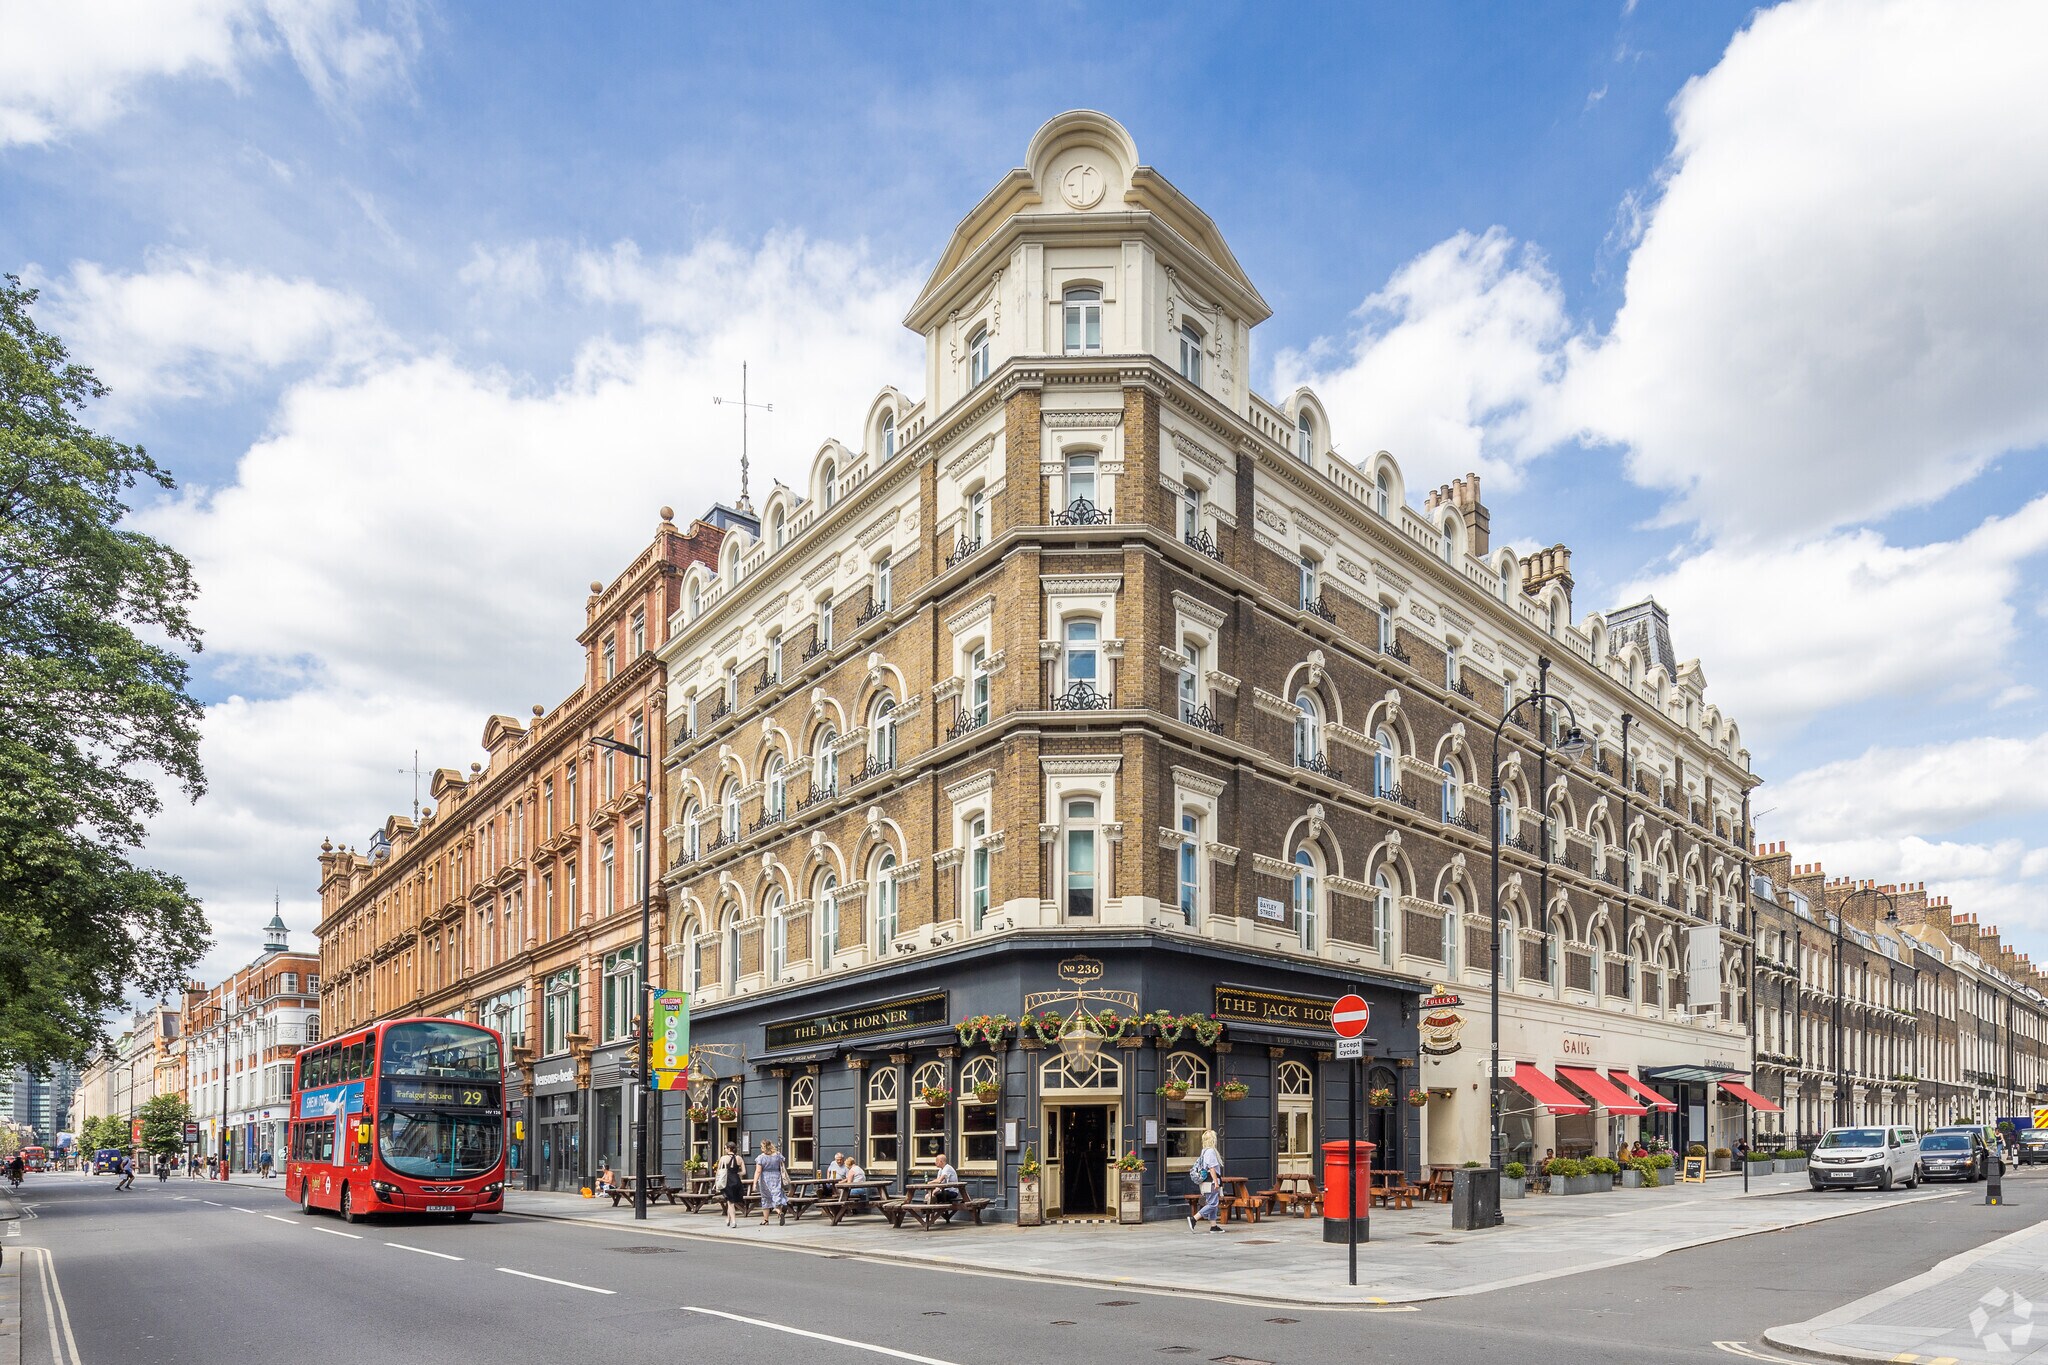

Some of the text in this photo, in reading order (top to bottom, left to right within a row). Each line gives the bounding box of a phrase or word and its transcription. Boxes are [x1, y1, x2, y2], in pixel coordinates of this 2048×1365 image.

[1260, 901, 1276, 911] BAYLEY
[1260, 909, 1276, 918] STREET
[1077, 964, 1099, 974] 236
[660, 997, 682, 1005] WELCOME
[1426, 995, 1455, 1005] FULLER'S
[1222, 997, 1332, 1021] THE JACK HOR
[794, 1010, 908, 1039] THE JACK HORNER
[1339, 1041, 1360, 1049] Except
[1563, 1039, 1590, 1055] GAIL's
[1339, 1048, 1359, 1056] cycles
[1488, 1065, 1513, 1073] GIL's
[395, 1090, 482, 1105] Trafalgar Square 29
